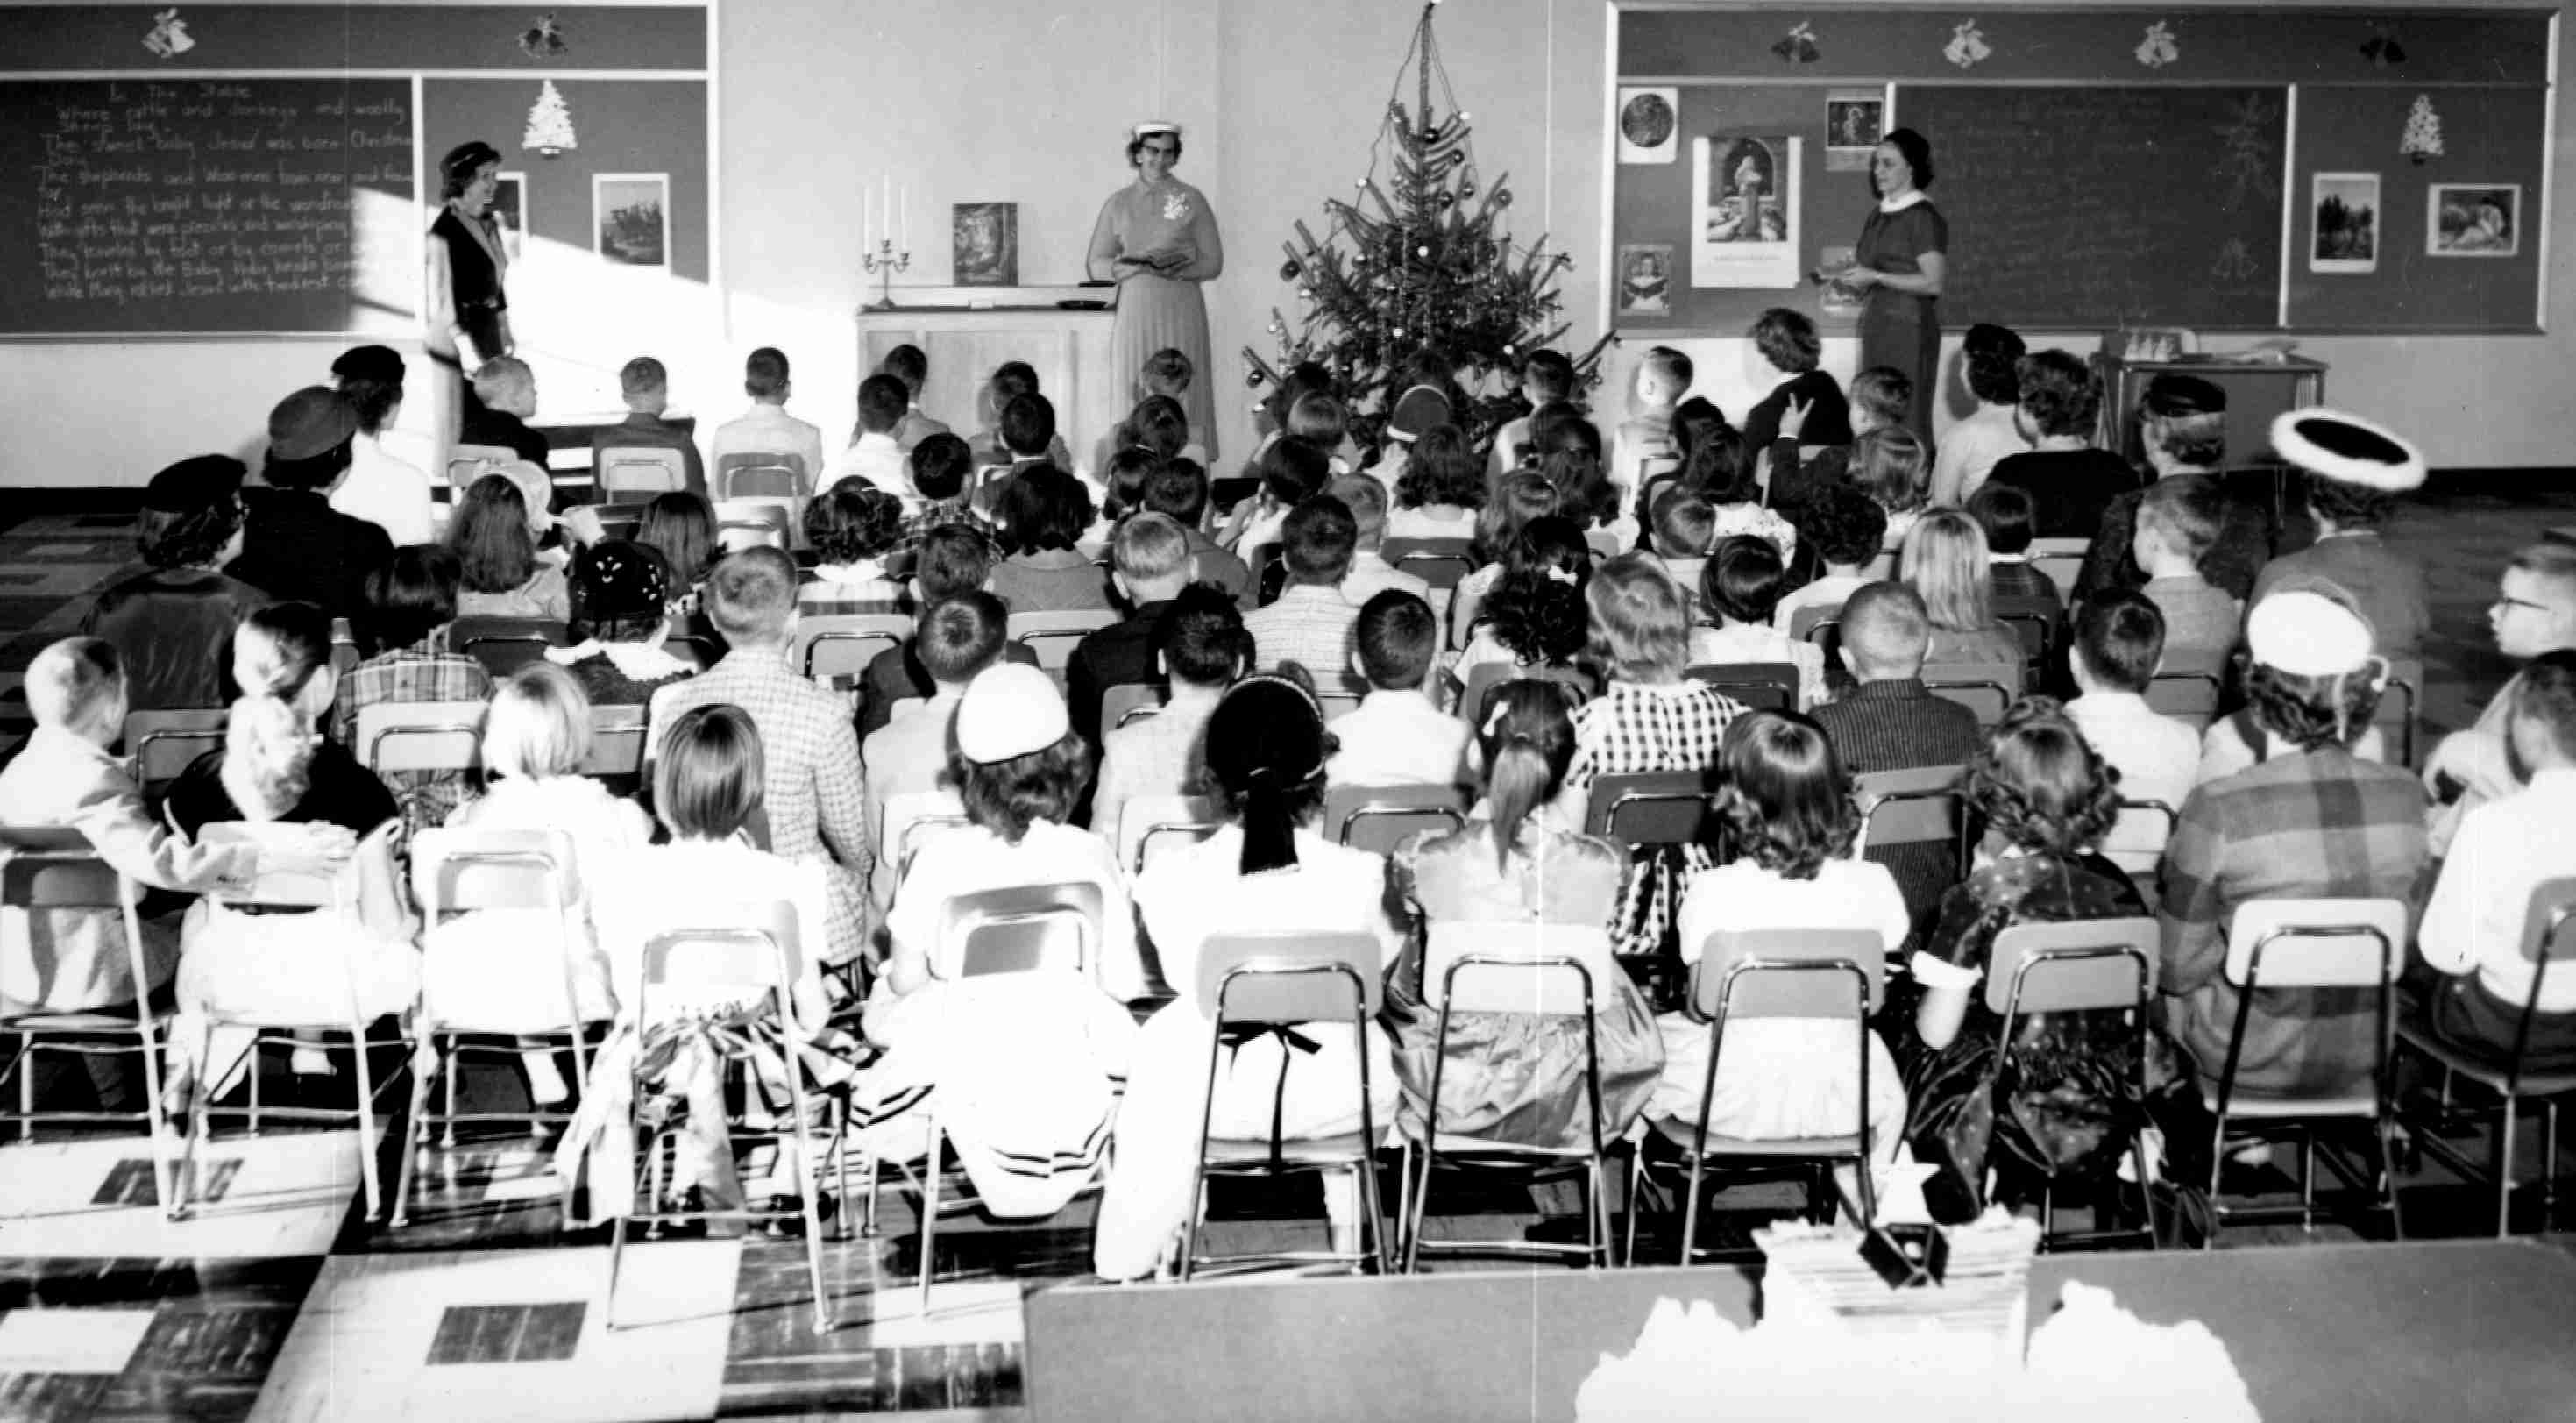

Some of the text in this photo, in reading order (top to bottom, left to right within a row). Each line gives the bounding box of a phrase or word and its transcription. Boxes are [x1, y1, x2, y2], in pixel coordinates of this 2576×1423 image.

[181, 102, 213, 118] and
[314, 97, 344, 115] and
[125, 196, 148, 216] the
[260, 189, 280, 211] the
